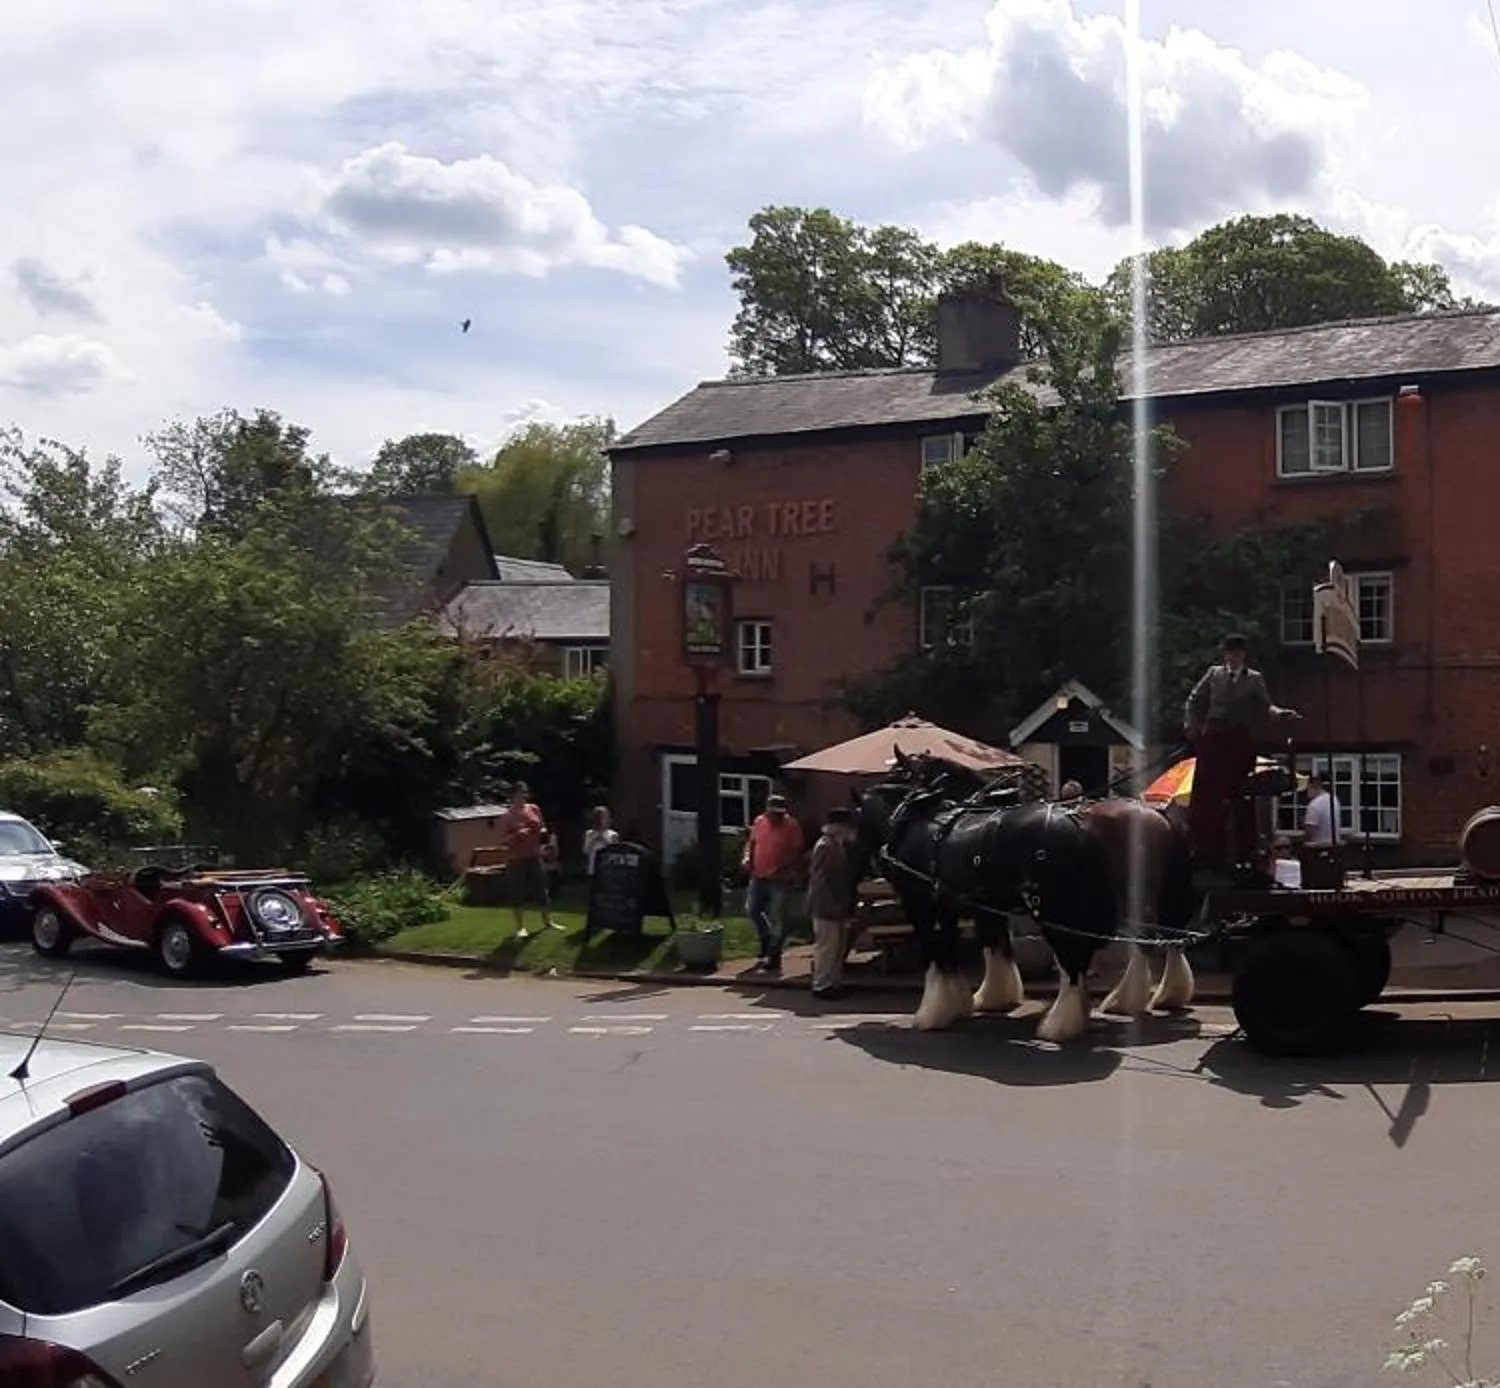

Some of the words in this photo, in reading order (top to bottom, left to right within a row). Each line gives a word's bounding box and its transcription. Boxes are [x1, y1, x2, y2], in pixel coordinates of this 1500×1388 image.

[685, 504, 753, 539] PEAR
[767, 500, 834, 534] TREE
[1308, 892, 1364, 905] HOOK
[1370, 887, 1443, 902] NORTON
